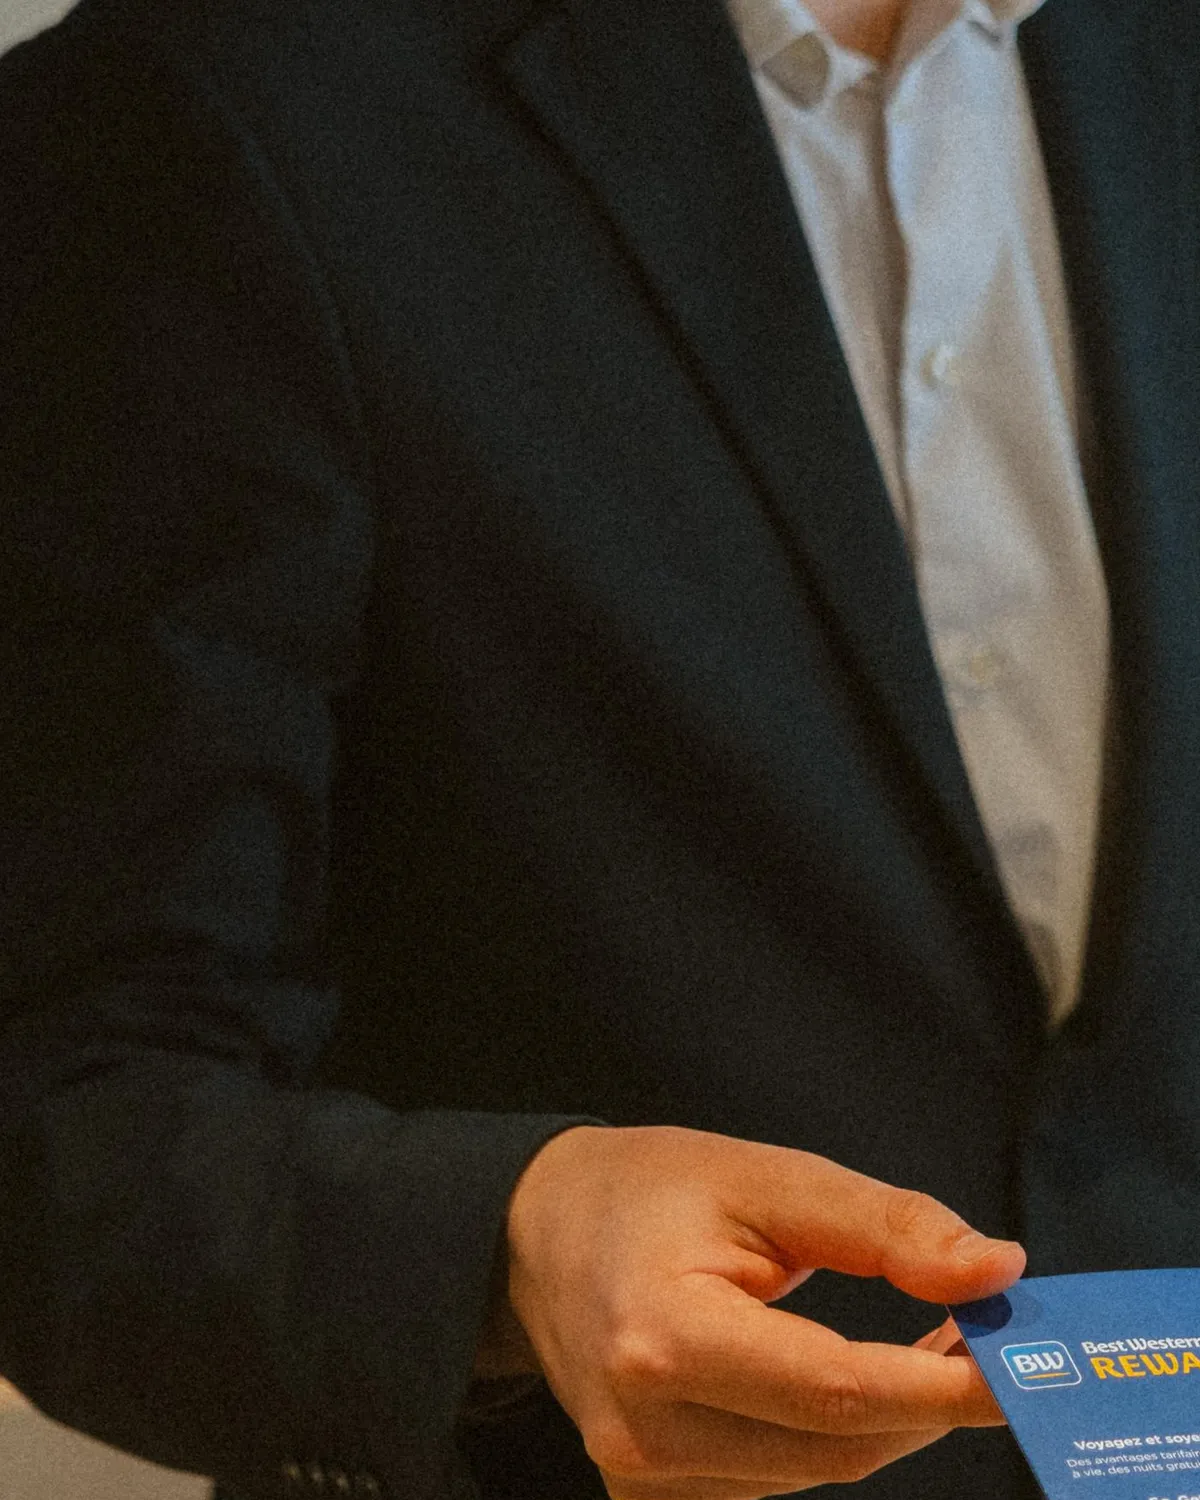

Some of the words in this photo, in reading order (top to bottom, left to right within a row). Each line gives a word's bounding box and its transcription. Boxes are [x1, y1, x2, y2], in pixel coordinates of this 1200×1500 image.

[1081, 1340, 1127, 1354] Best
[1012, 1350, 1065, 1374] BW
[1073, 1437, 1142, 1451] Voyagez
[1146, 1434, 1162, 1446] et
[1066, 1457, 1092, 1468] Des
[1095, 1452, 1158, 1466] avantages
[1072, 1468, 1080, 1479] à
[1082, 1466, 1105, 1478] vie,
[1108, 1463, 1130, 1475] des
[1133, 1461, 1164, 1472] nuits
